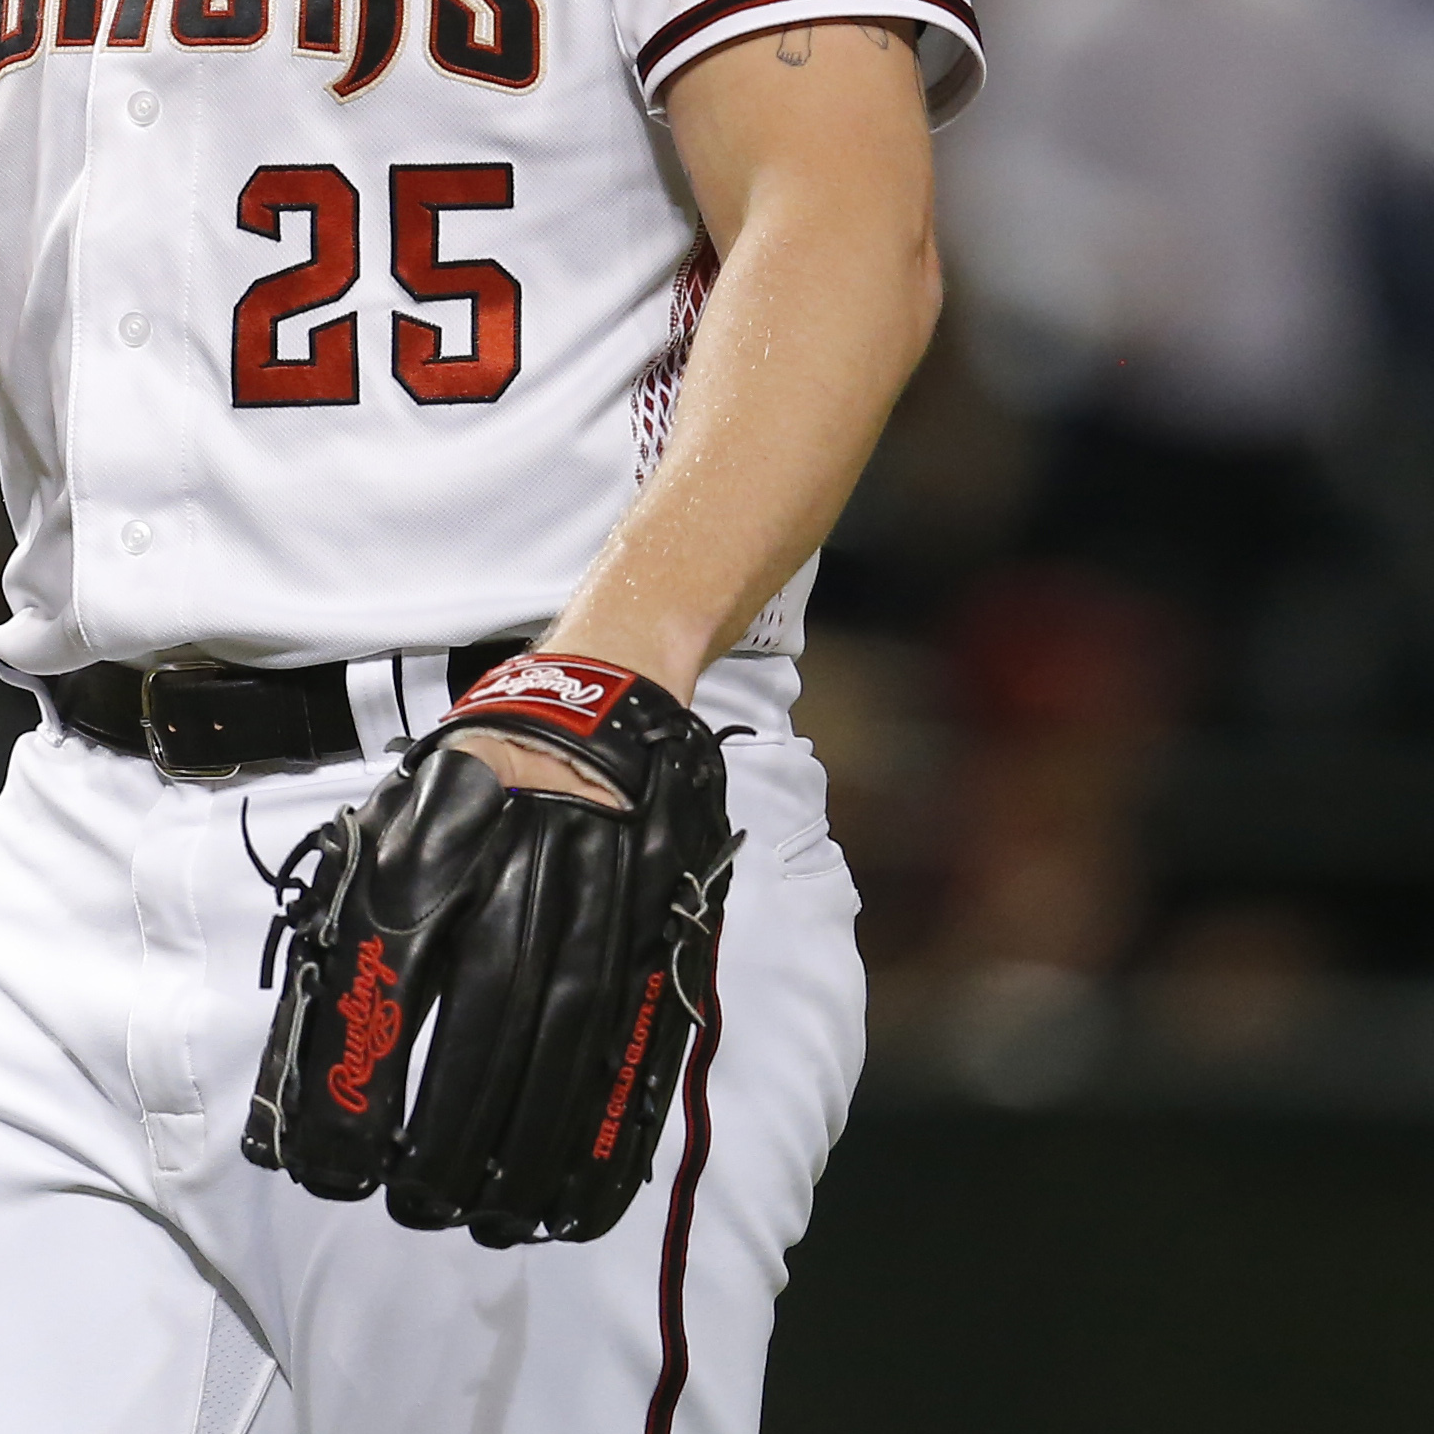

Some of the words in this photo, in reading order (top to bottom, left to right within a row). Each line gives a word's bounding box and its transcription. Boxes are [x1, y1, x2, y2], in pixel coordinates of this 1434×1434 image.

[231, 161, 523, 409] 25
[327, 934, 402, 1113] Rawlings
[624, 1003, 656, 1065] GLOVE
[607, 1066, 636, 1118] GOLD
[593, 1118, 622, 1160] THE
